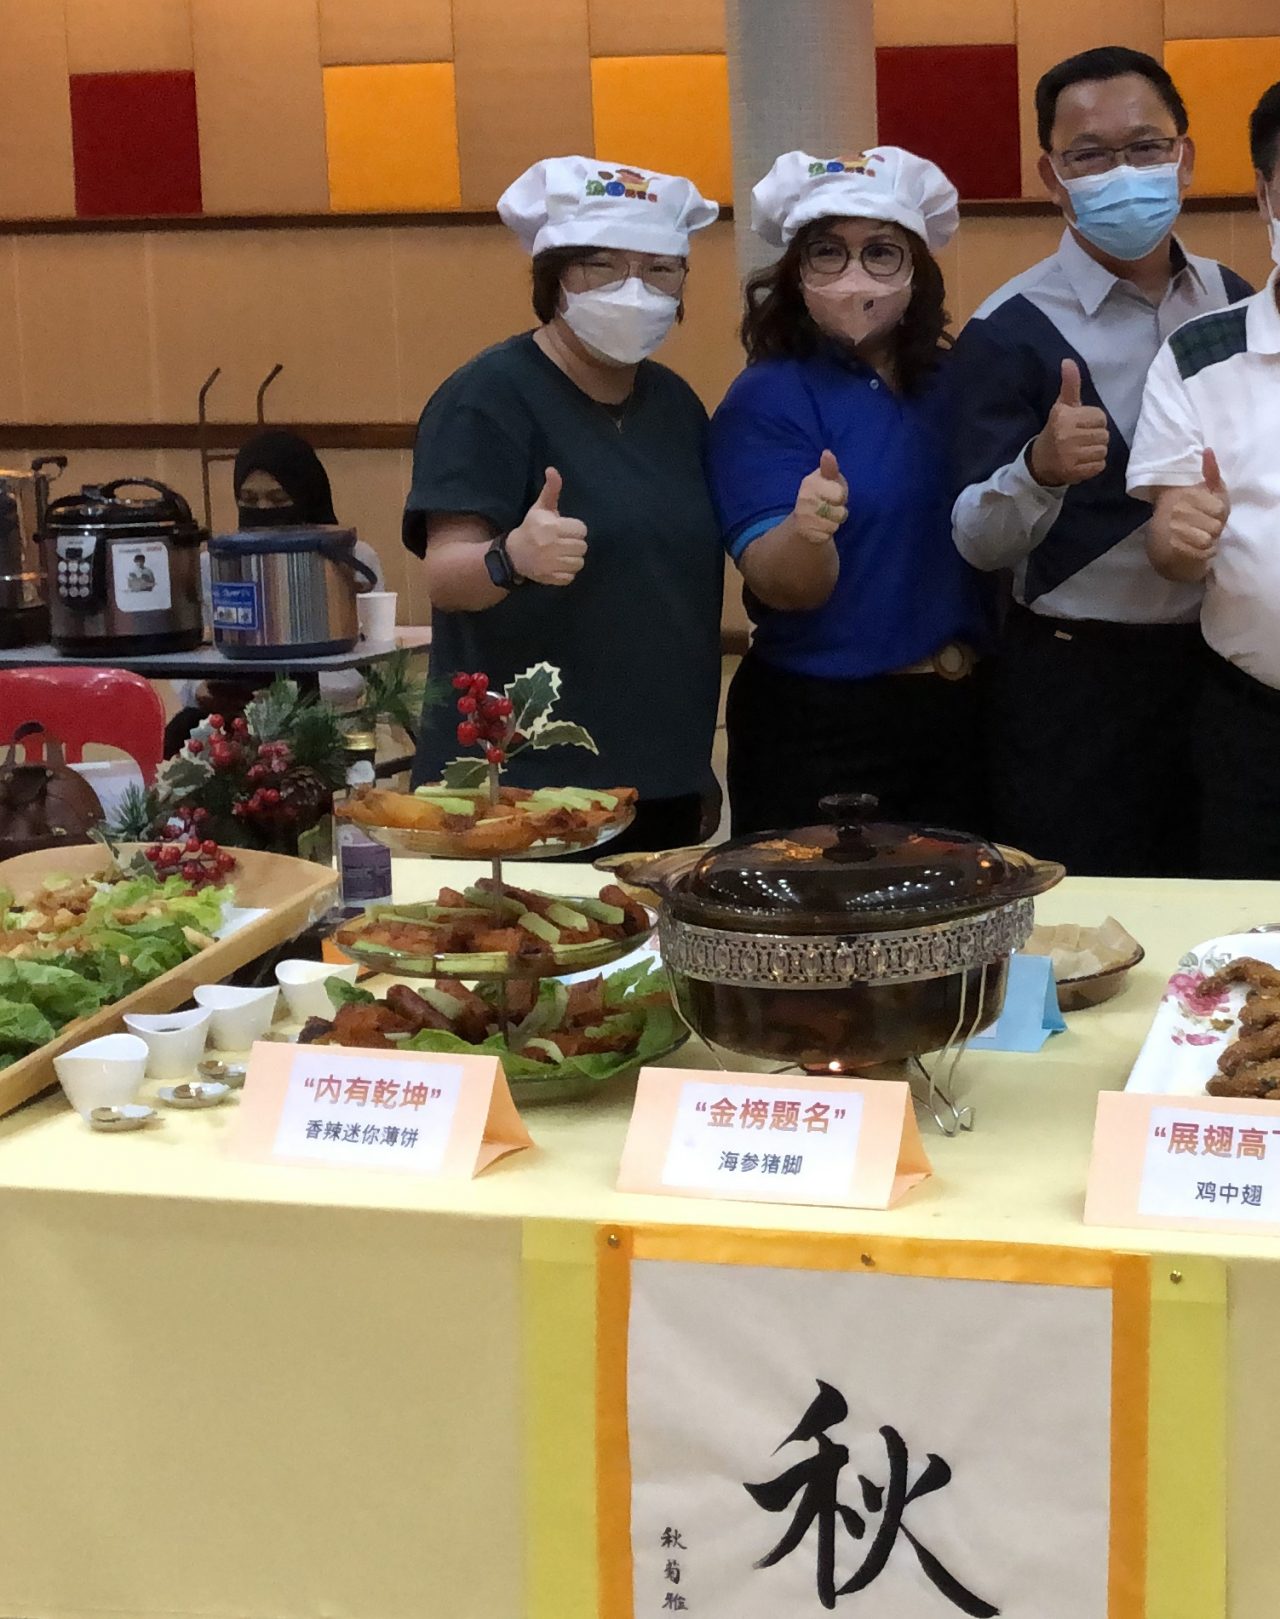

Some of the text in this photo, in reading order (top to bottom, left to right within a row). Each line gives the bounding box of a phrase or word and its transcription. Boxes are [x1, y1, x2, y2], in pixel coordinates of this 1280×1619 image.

[304, 1074, 442, 1111] “内有乾坤”
[695, 1097, 846, 1134] “金榜题名”
[305, 1119, 419, 1148] 香辣迷你薄饼
[717, 1151, 803, 1175] 海参猪脚
[1195, 1181, 1263, 1206] 鸡中翅
[743, 1378, 1002, 1619] 秋
